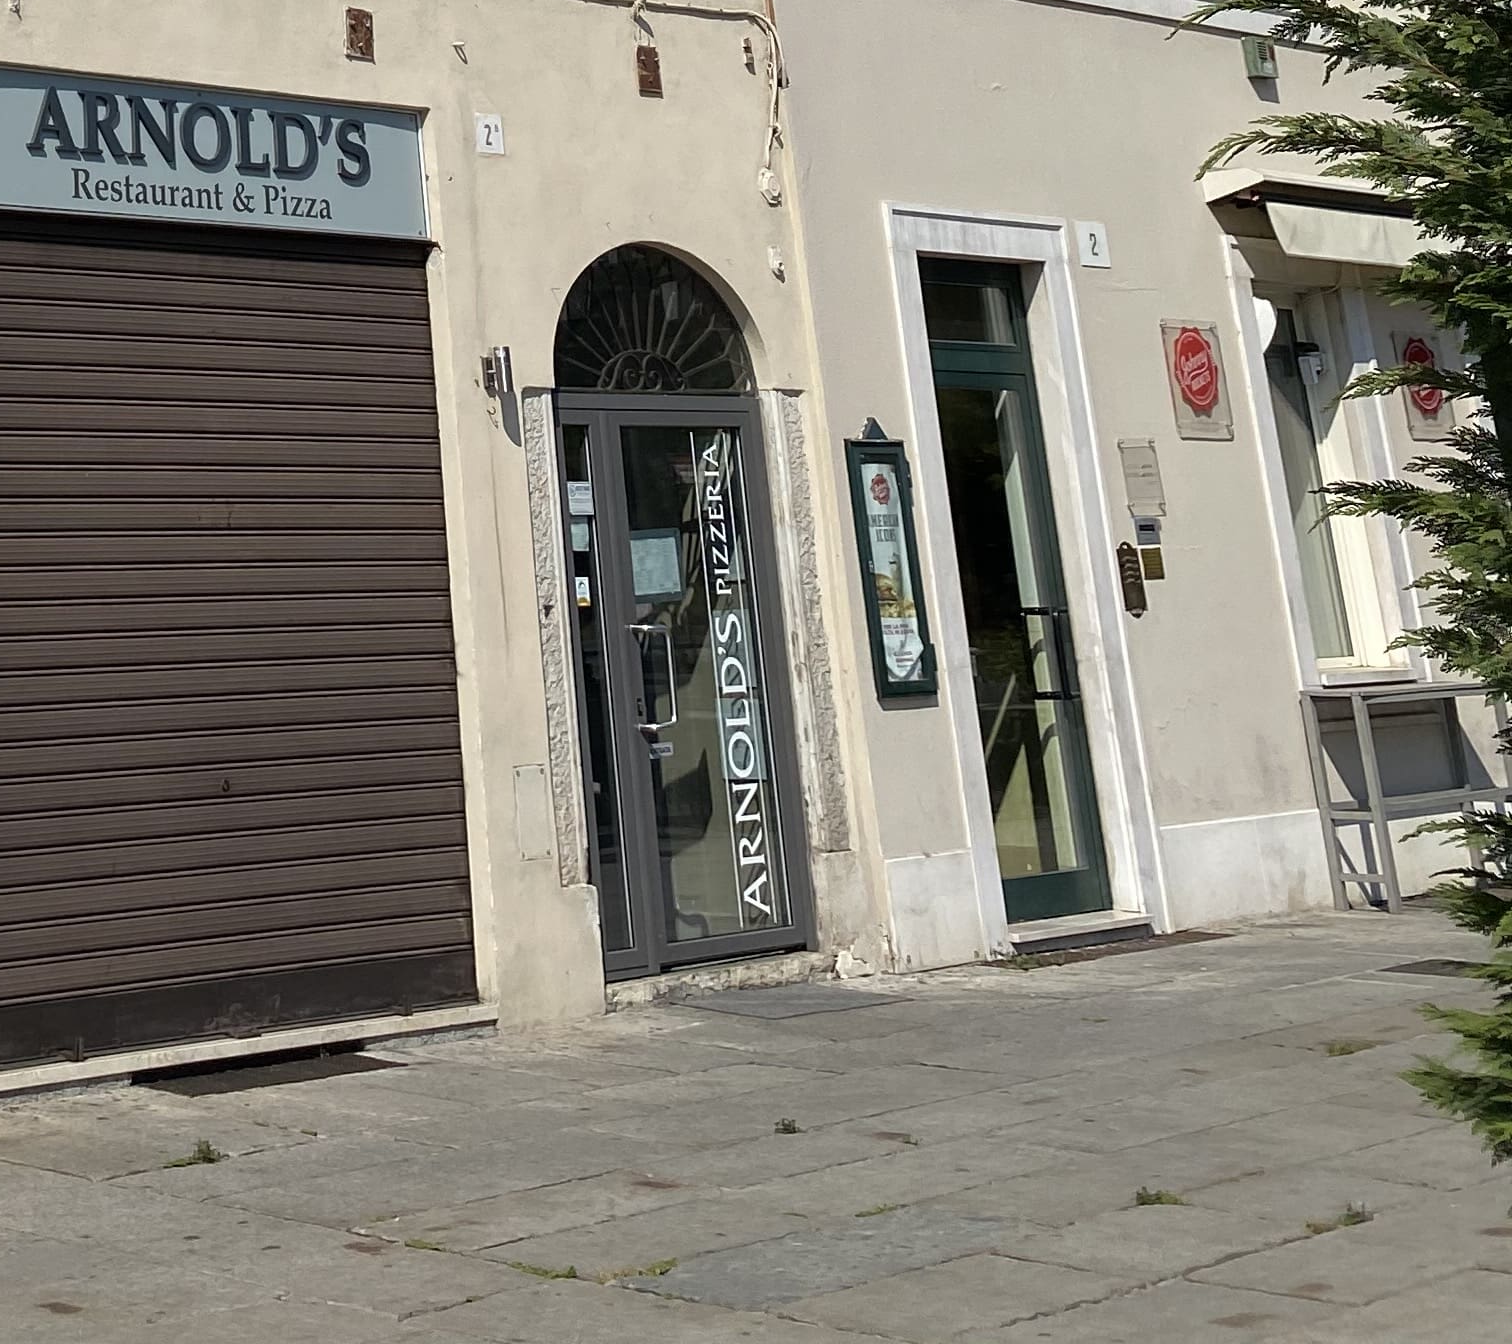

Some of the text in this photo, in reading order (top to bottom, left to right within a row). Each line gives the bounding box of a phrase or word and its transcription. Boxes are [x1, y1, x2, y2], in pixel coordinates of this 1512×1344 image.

[25, 85, 371, 187] ARNOLD'S
[71, 168, 333, 220] Restaurant & Pizza
[1089, 233, 1099, 257] 2
[702, 444, 772, 916] ARNOLD'S PIZZERIA
